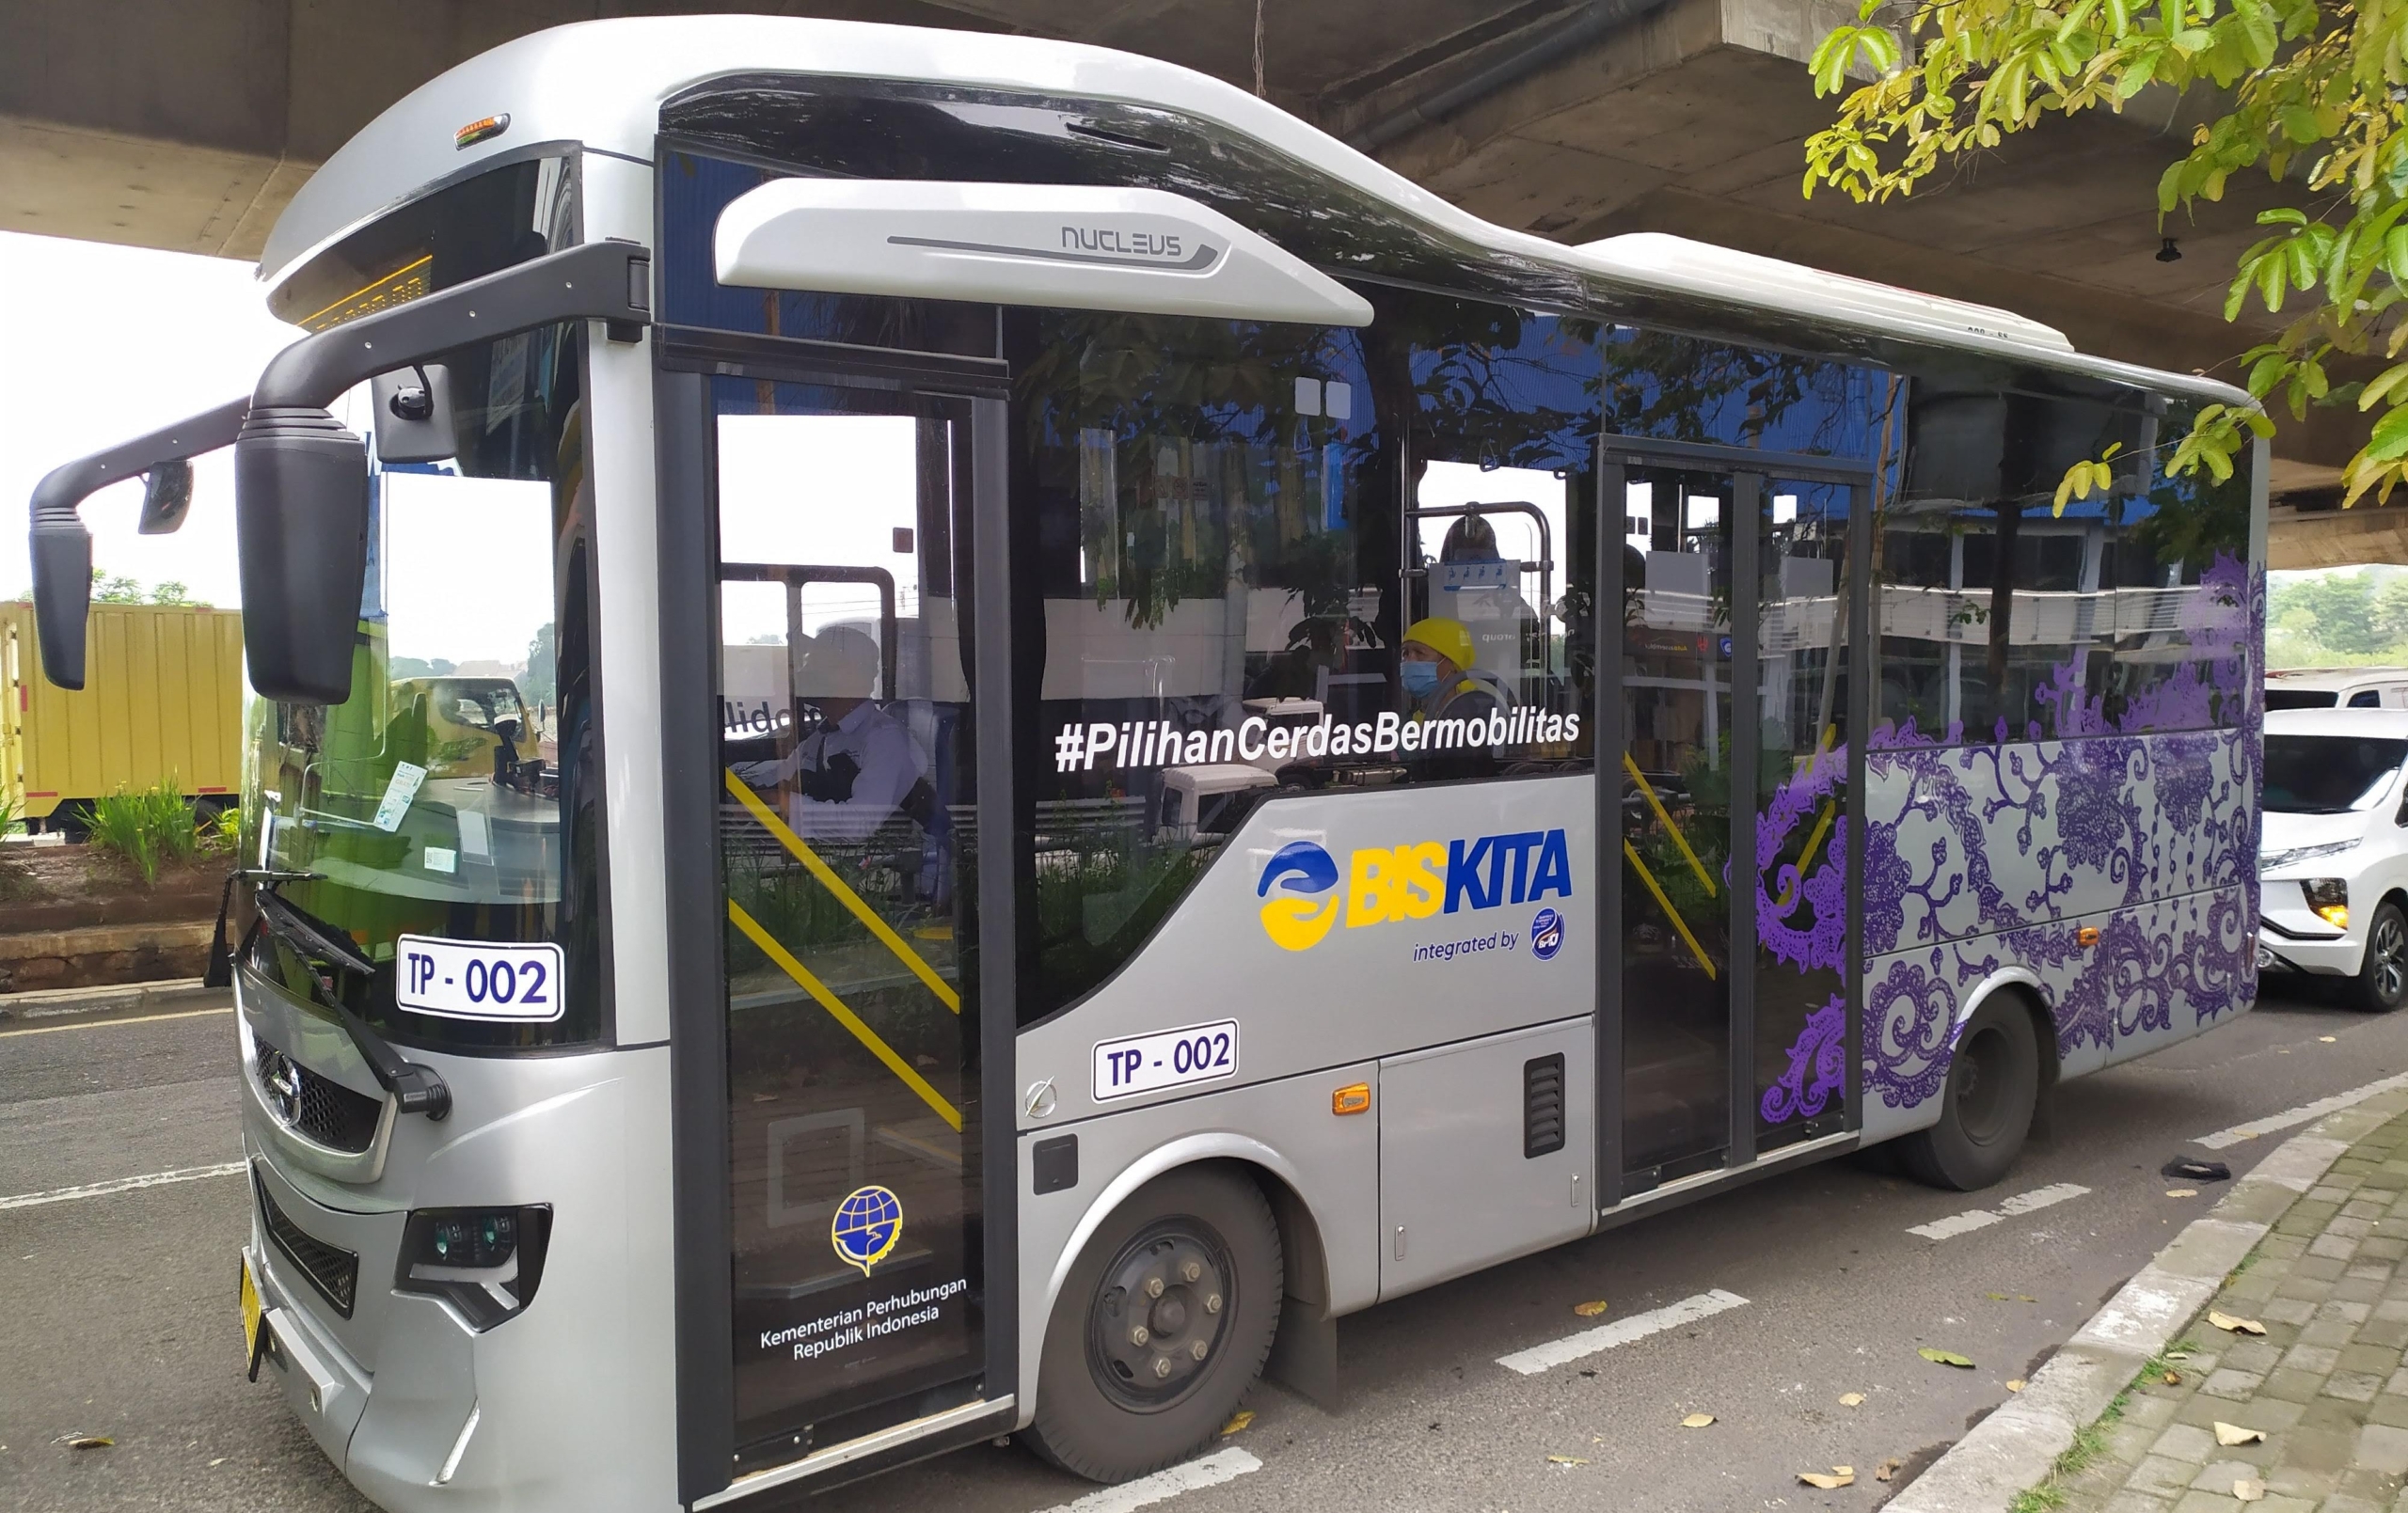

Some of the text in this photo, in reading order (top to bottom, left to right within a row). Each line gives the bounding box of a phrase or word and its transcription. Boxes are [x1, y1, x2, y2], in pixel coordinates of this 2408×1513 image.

[1062, 227, 1181, 256] NUCLEUS
[1054, 706, 1580, 772] #PilihanCerdasBermobilitas
[1346, 828, 1572, 928] BISKITA
[1413, 929, 1519, 962] integrated by
[407, 953, 435, 995] TP
[466, 958, 547, 1003] 002
[1107, 1048, 1142, 1086] TP
[1173, 1032, 1229, 1074] 002
[760, 1278, 967, 1348] Kementerian Perhubungan
[793, 1305, 940, 1361] Republik Indonesia
